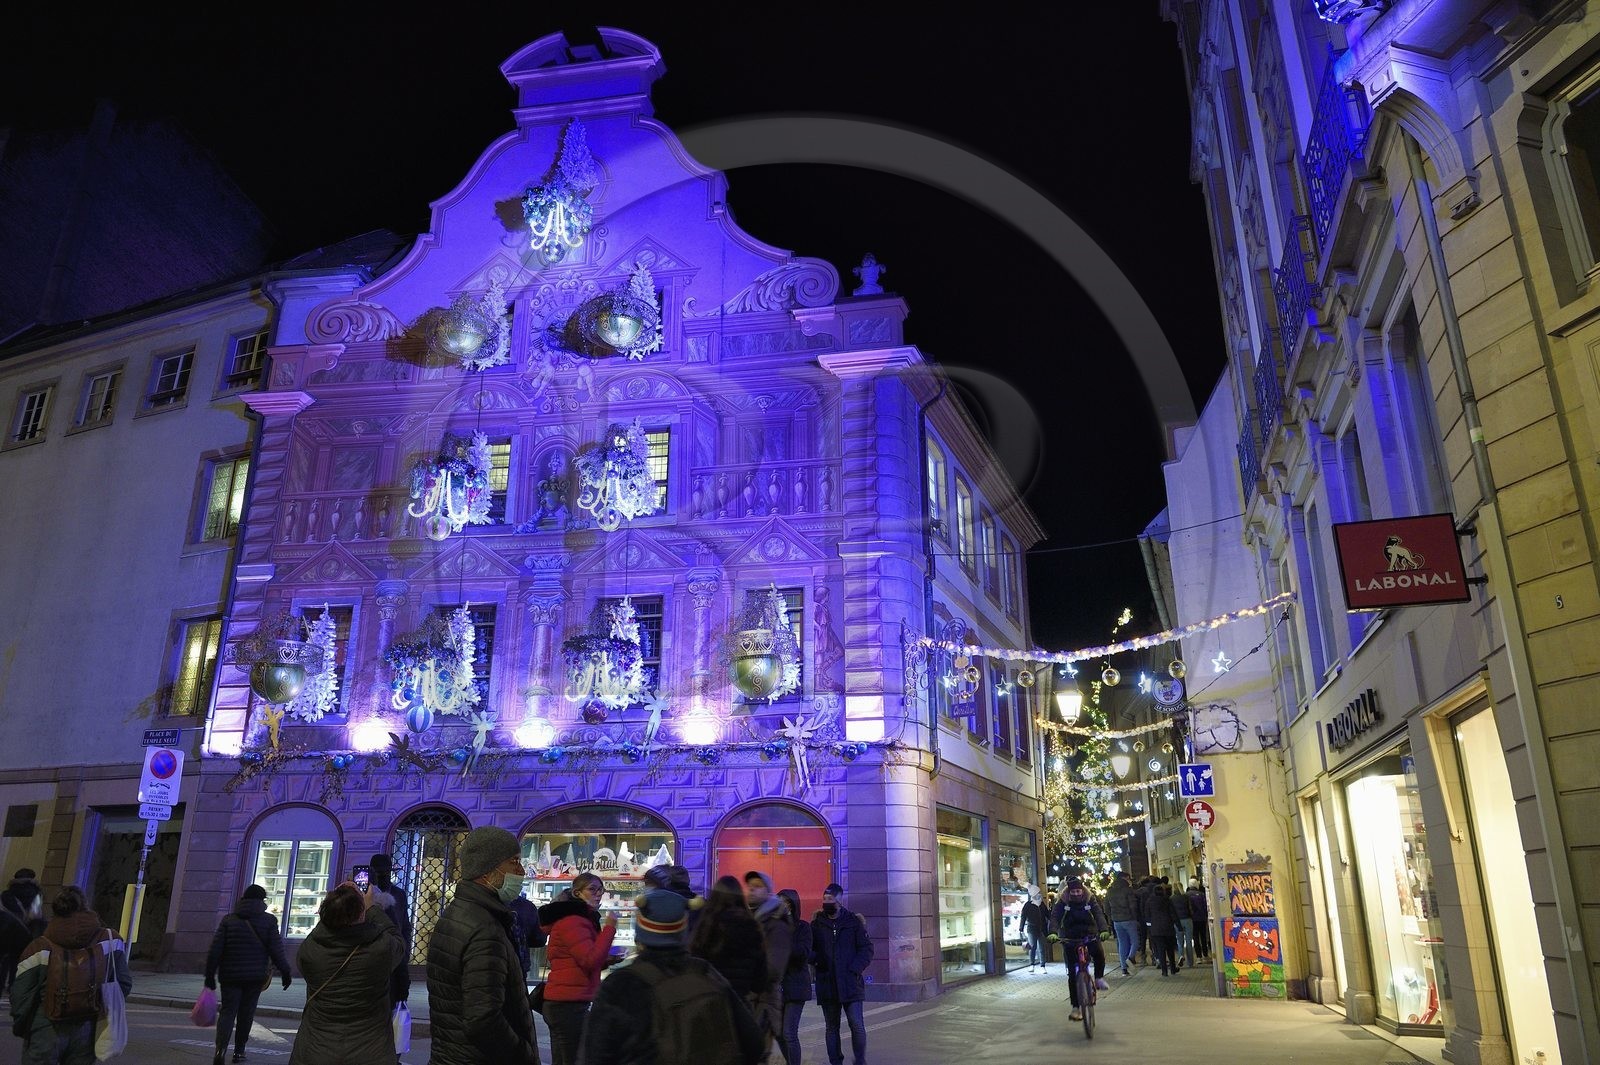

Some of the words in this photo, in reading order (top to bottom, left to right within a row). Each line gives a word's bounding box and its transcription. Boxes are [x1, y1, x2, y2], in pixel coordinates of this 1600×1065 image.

[1355, 571, 1457, 591] LABONAL
[1555, 595, 1564, 609] 5
[1326, 688, 1382, 752] LABONAL
